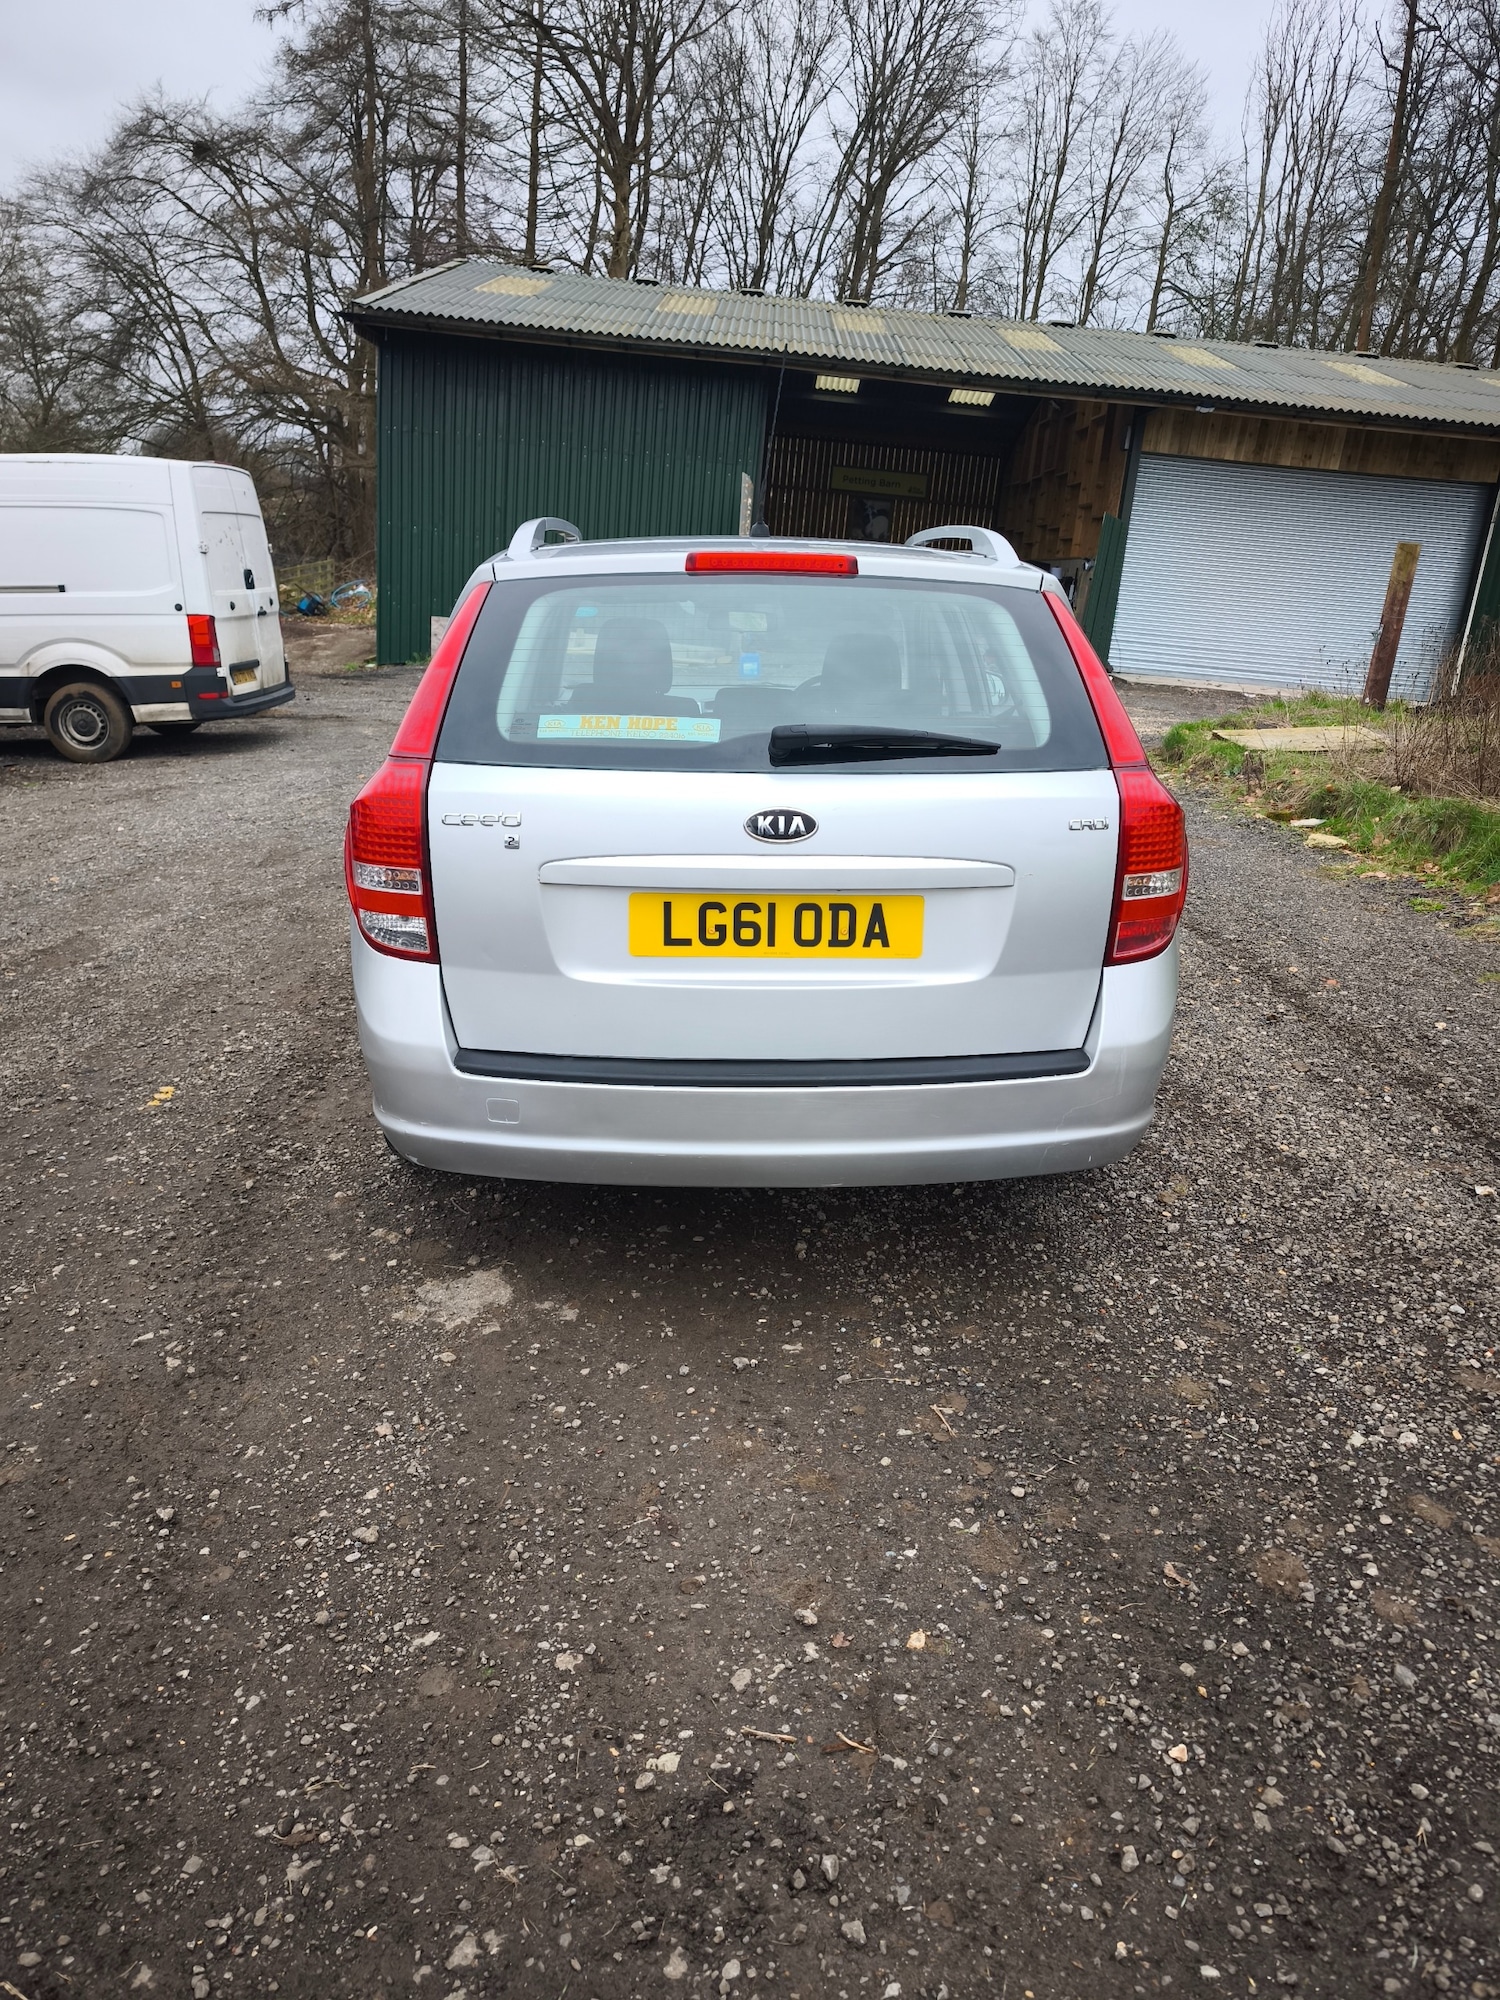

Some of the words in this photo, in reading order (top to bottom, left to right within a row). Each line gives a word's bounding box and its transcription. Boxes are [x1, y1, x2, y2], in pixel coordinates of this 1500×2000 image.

[842, 474, 877, 488] Petting
[879, 478, 902, 489] Barn
[580, 715, 620, 729] KEN
[627, 716, 678, 730] HOPE
[571, 729, 622, 737] TELEPHONE
[626, 730, 657, 738] KELSO
[756, 814, 808, 836] KIA
[662, 901, 777, 947] LG61
[793, 902, 891, 948] ODA
